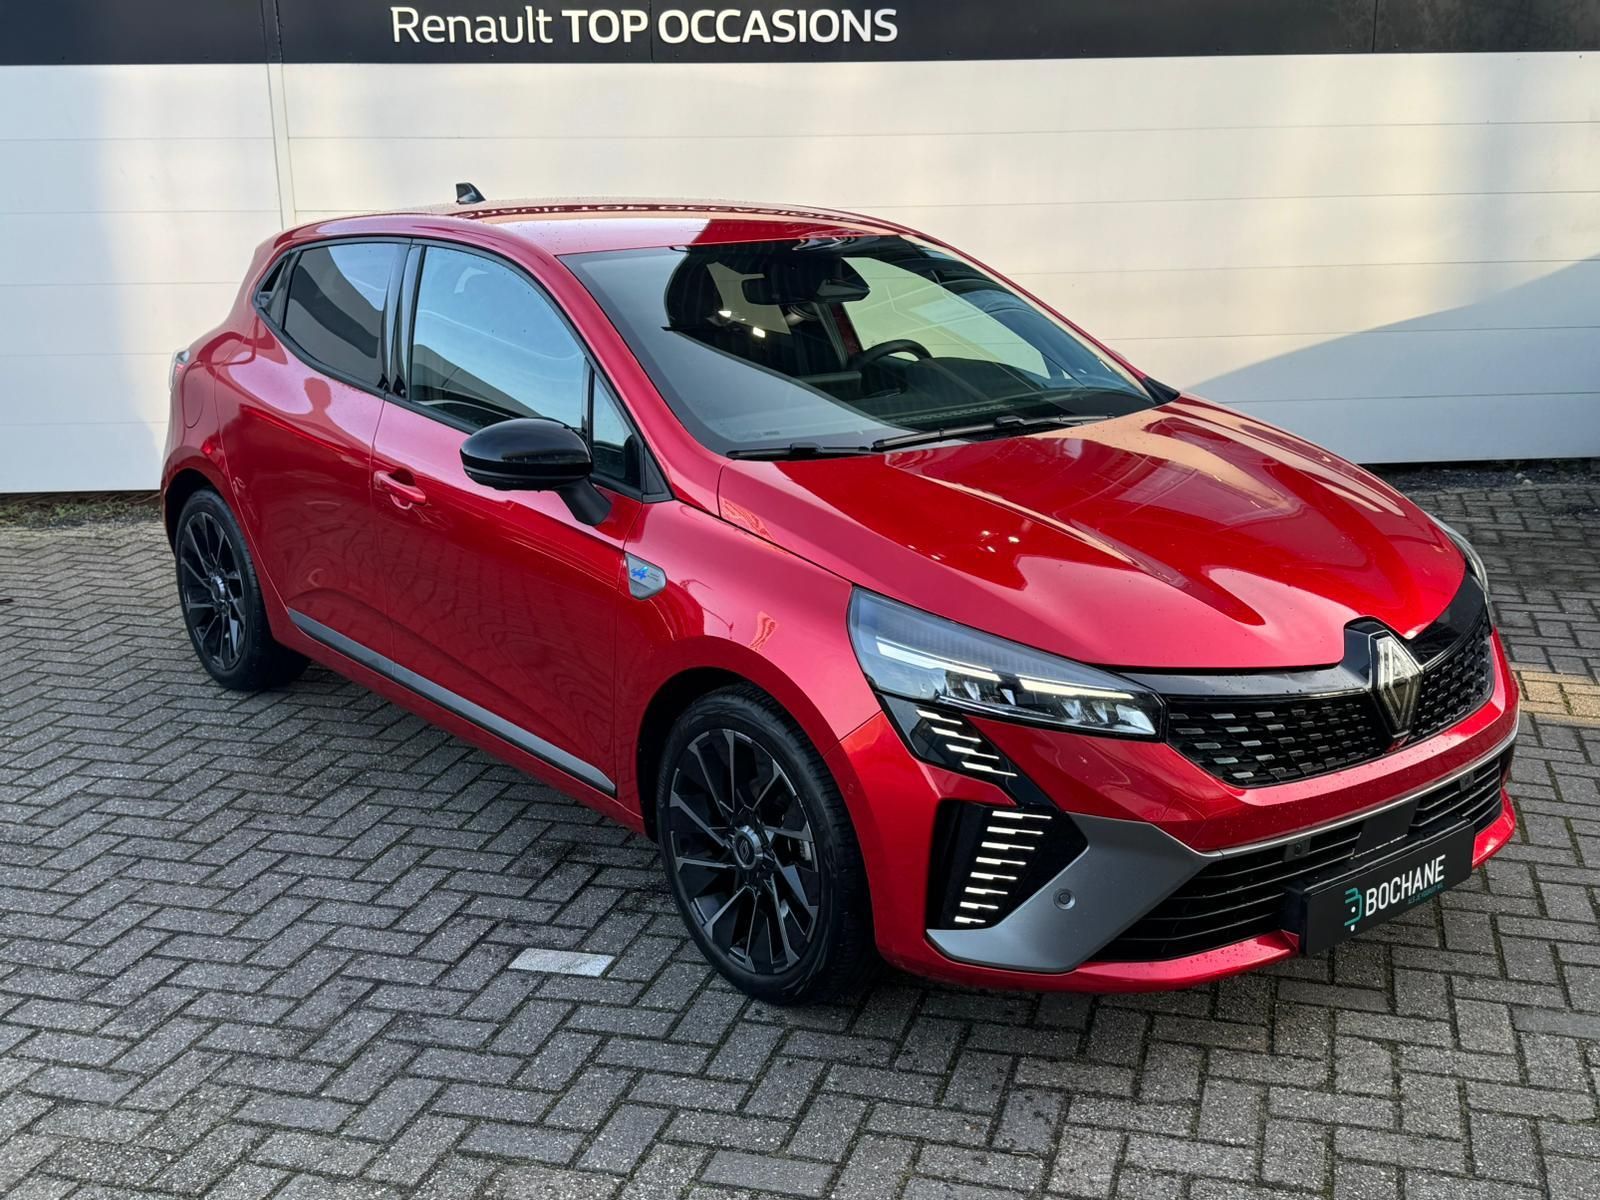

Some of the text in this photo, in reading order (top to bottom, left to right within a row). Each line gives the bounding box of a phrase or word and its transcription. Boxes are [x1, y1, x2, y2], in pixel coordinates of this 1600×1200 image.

[390, 6, 898, 43] Renault TOP OCCASIONS
[1365, 853, 1447, 917] BOCHANE
